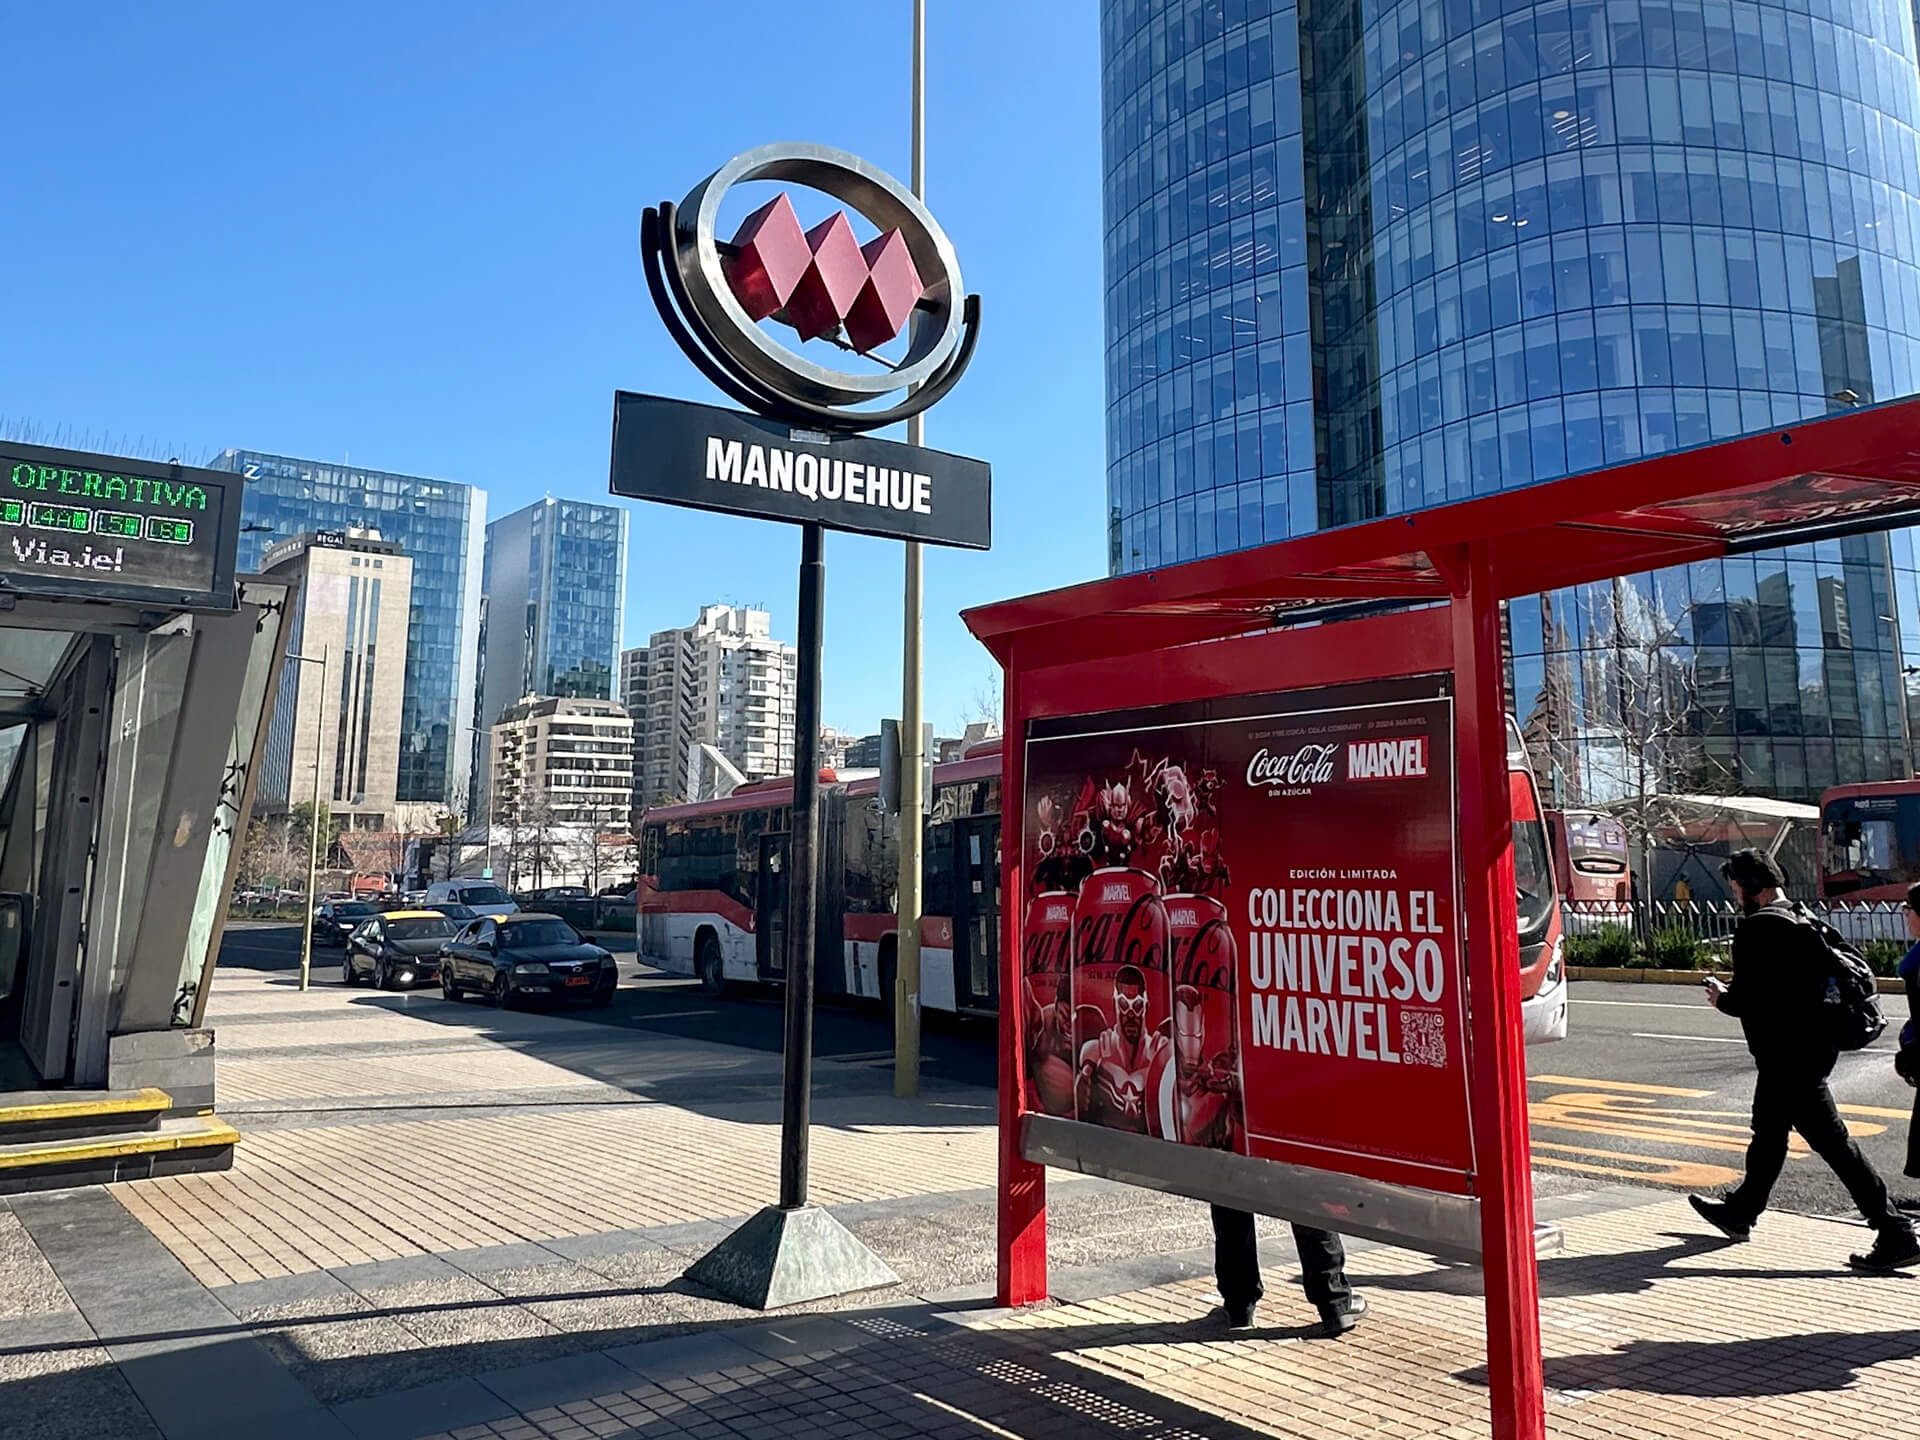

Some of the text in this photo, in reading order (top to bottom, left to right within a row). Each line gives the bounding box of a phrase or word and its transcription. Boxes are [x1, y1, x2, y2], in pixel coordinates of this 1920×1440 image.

[11, 463, 207, 511] OPERATIVA
[706, 436, 932, 515] MANQUEHUE
[12, 536, 124, 572] Viaje!
[316, 534, 344, 545] REGAL
[1246, 743, 1339, 787] Coca-Cola
[1348, 738, 1427, 780] MARVEL
[1103, 884, 1131, 901] MARVEL
[1289, 868, 1398, 880] EDICIÓN LIMITADA
[1170, 908, 1198, 927] MARVEL
[1249, 887, 1443, 934] COLECCIONA EL
[1250, 931, 1444, 1003] UNIVERSO
[1251, 992, 1401, 1064] MARVEL
